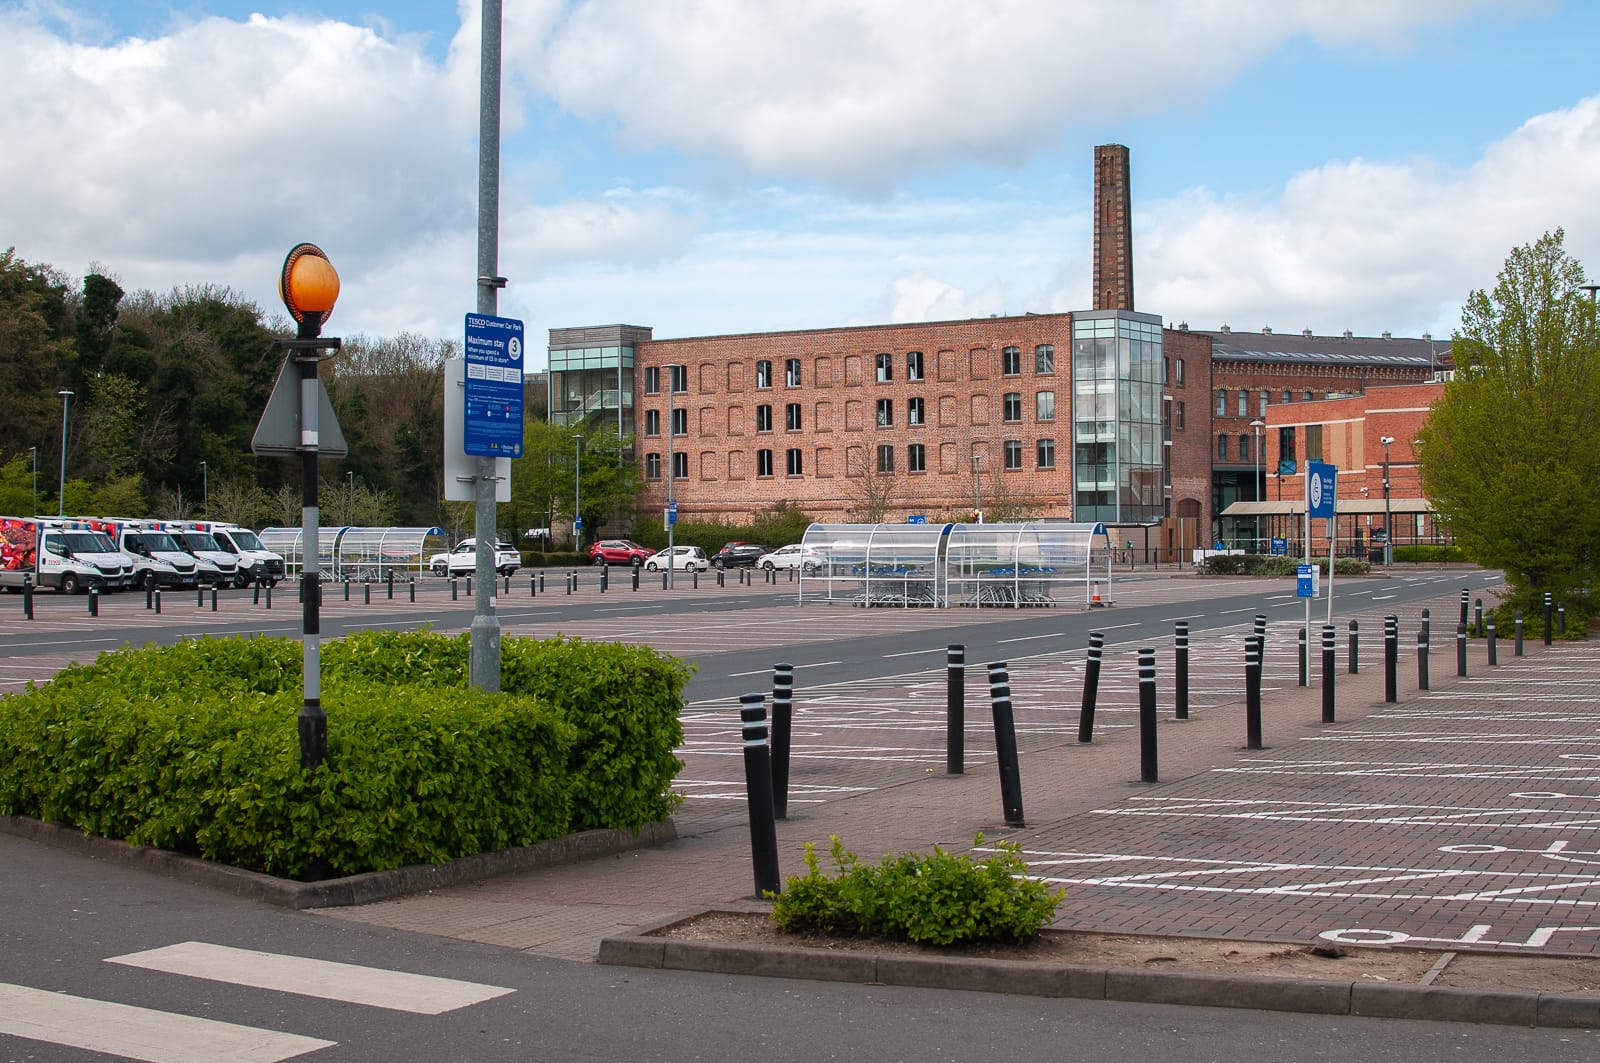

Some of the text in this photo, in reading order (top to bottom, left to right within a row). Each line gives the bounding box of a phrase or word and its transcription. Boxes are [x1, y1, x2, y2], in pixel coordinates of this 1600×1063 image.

[468, 318, 485, 327] TESCO
[486, 320, 504, 328] Customer
[513, 323, 521, 331] Park
[467, 335, 504, 350] Maximum stay
[512, 339, 518, 353] 3
